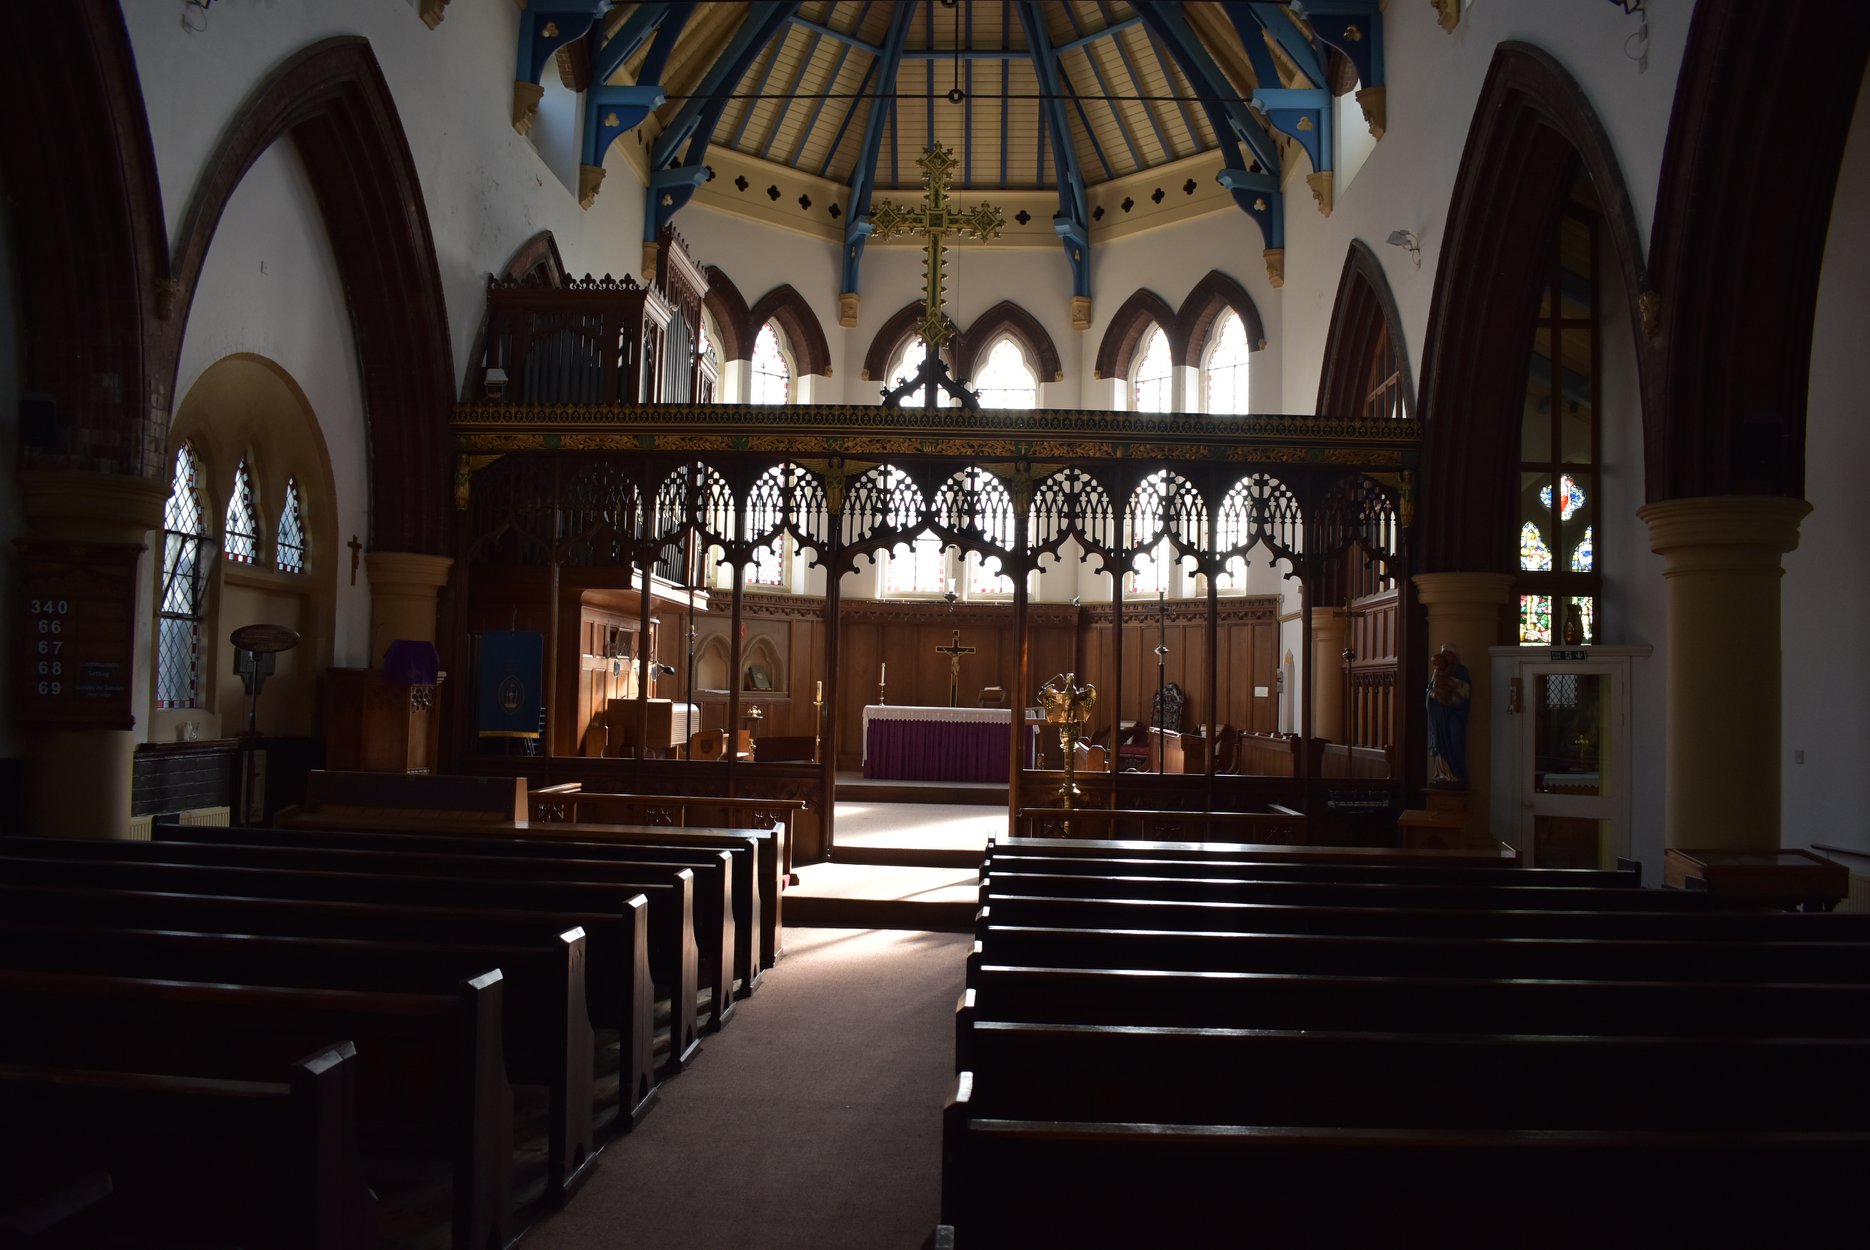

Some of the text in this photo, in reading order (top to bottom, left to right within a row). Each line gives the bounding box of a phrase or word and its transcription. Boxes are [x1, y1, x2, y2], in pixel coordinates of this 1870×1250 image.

[31, 600, 68, 614] 340
[38, 619, 62, 634] 66
[38, 640, 63, 655] 67
[38, 660, 62, 675] 68
[38, 681, 62, 695] 69
